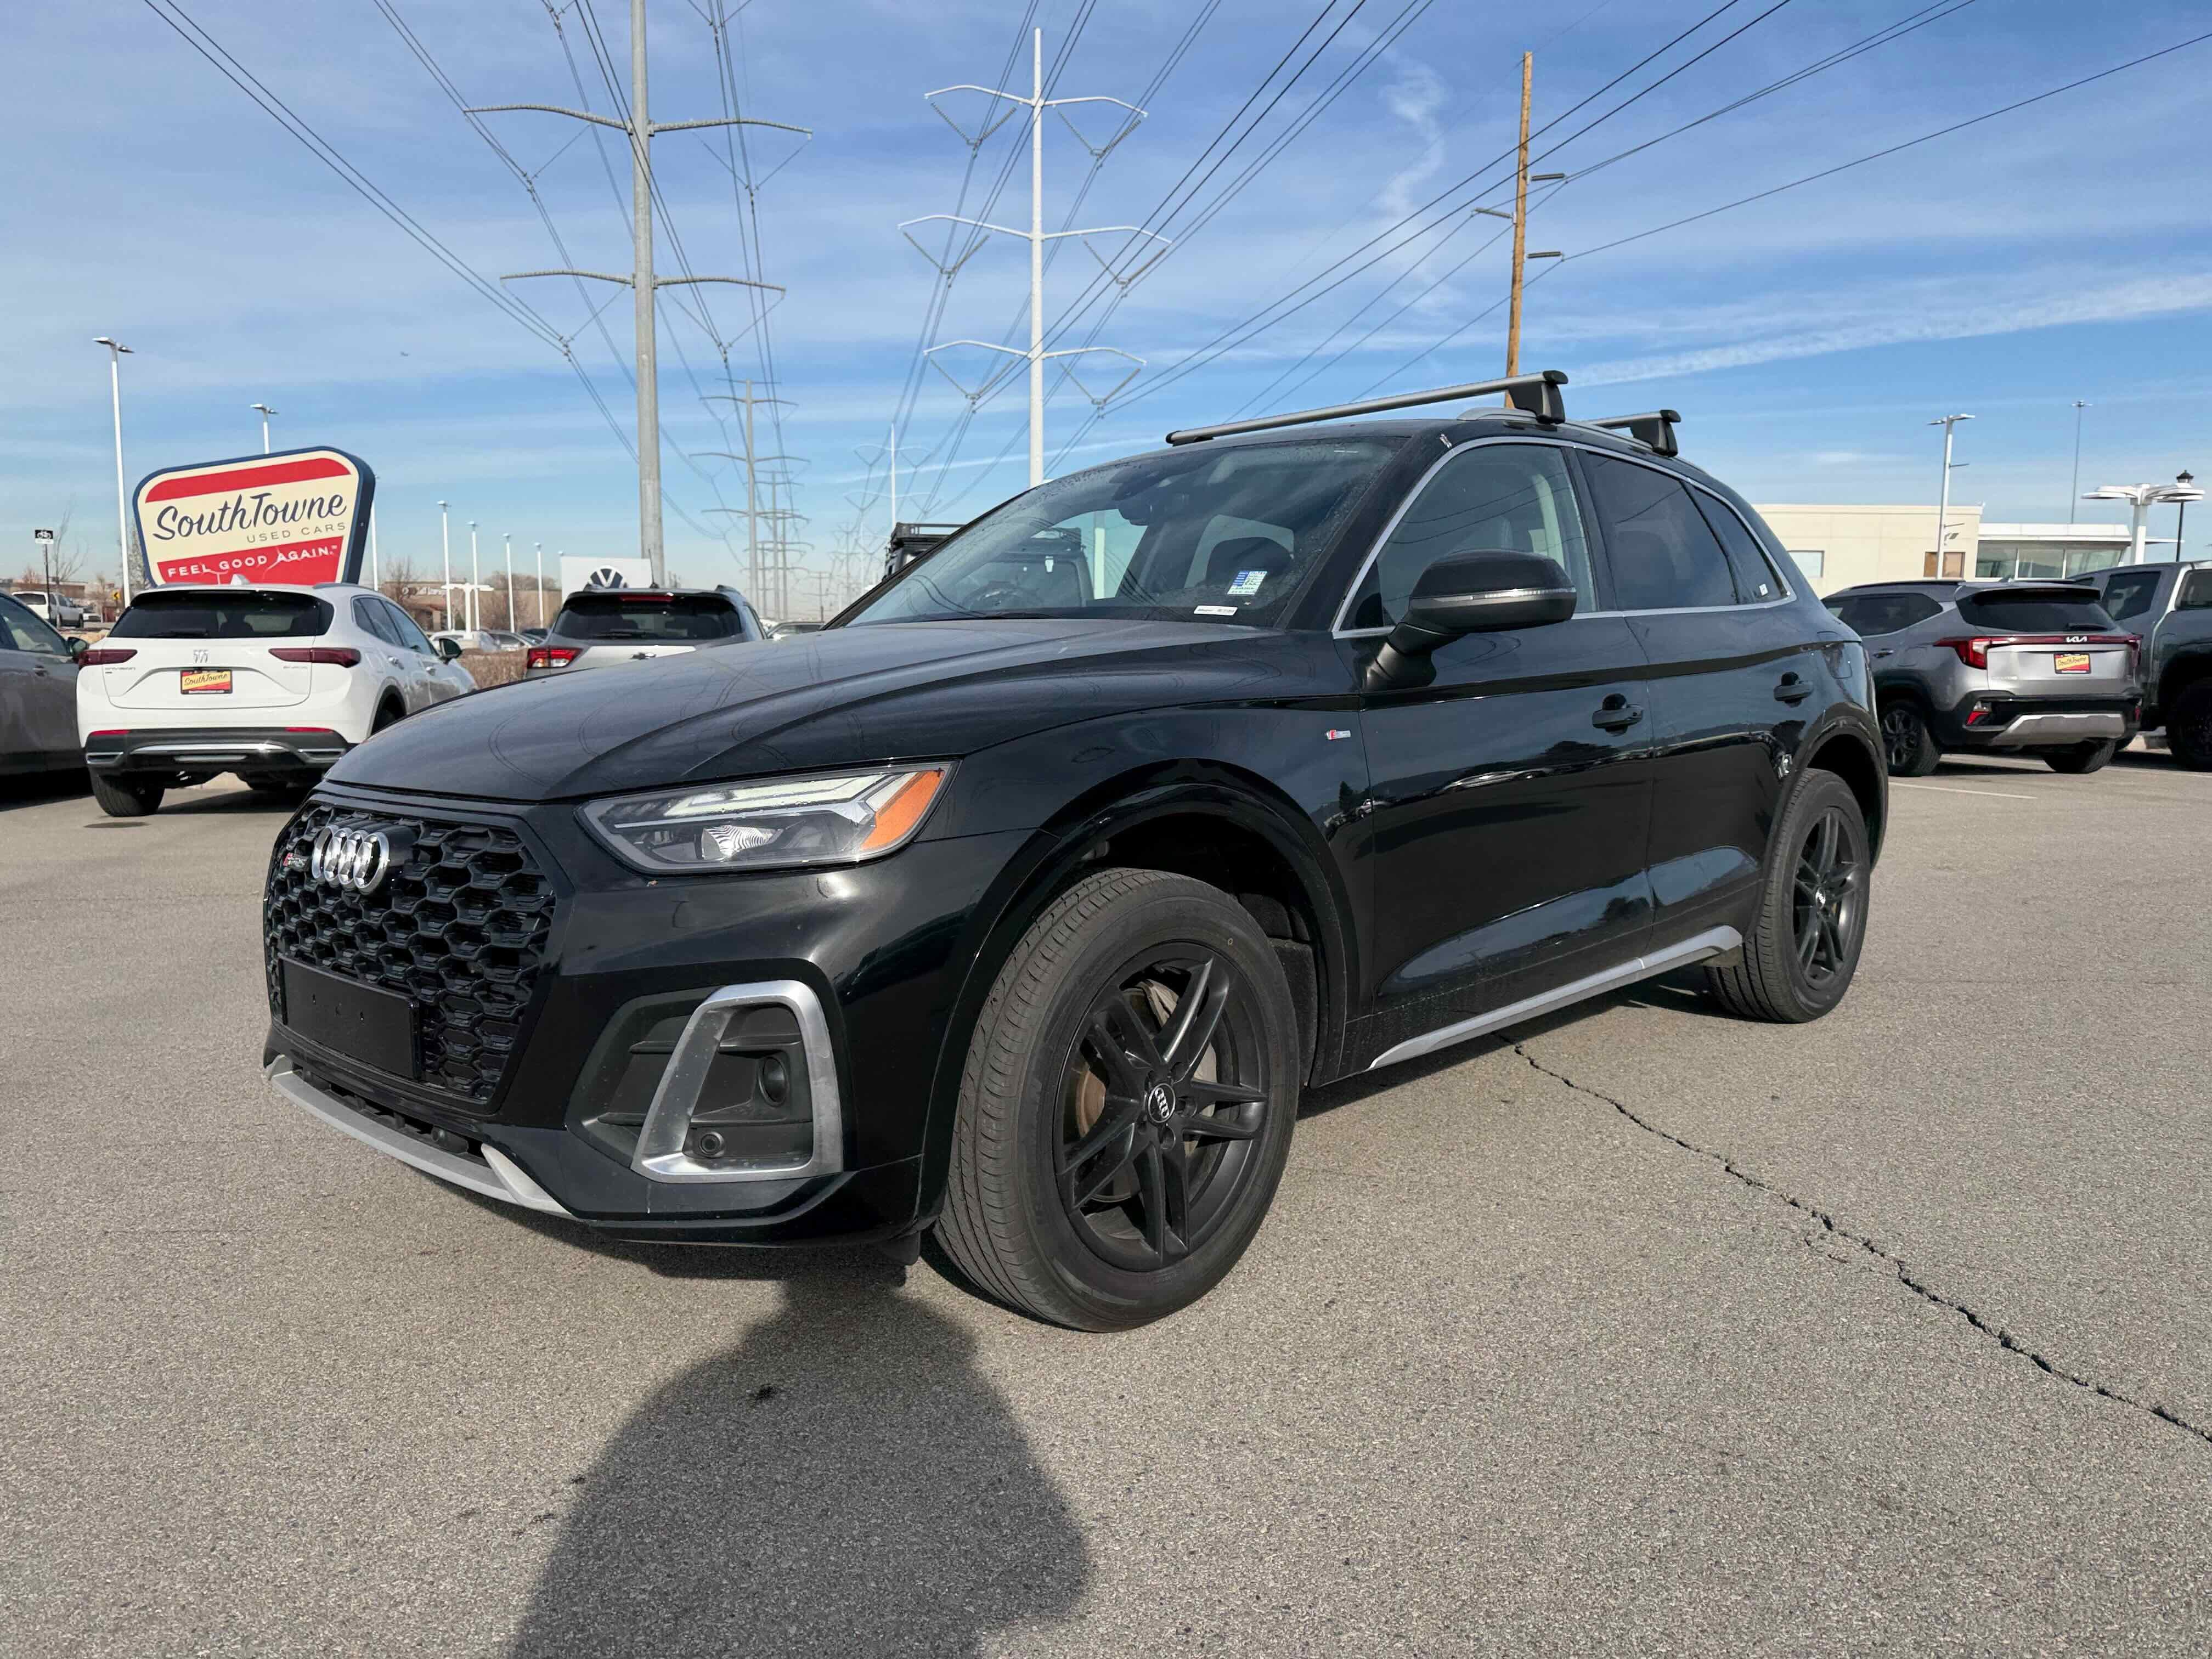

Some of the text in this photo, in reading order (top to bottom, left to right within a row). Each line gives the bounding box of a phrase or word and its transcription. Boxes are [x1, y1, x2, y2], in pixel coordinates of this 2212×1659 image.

[153, 493, 347, 540] SouthTowne
[246, 522, 346, 543] USED CARS
[167, 564, 212, 577] FEEL
[219, 555, 268, 569] GOOD
